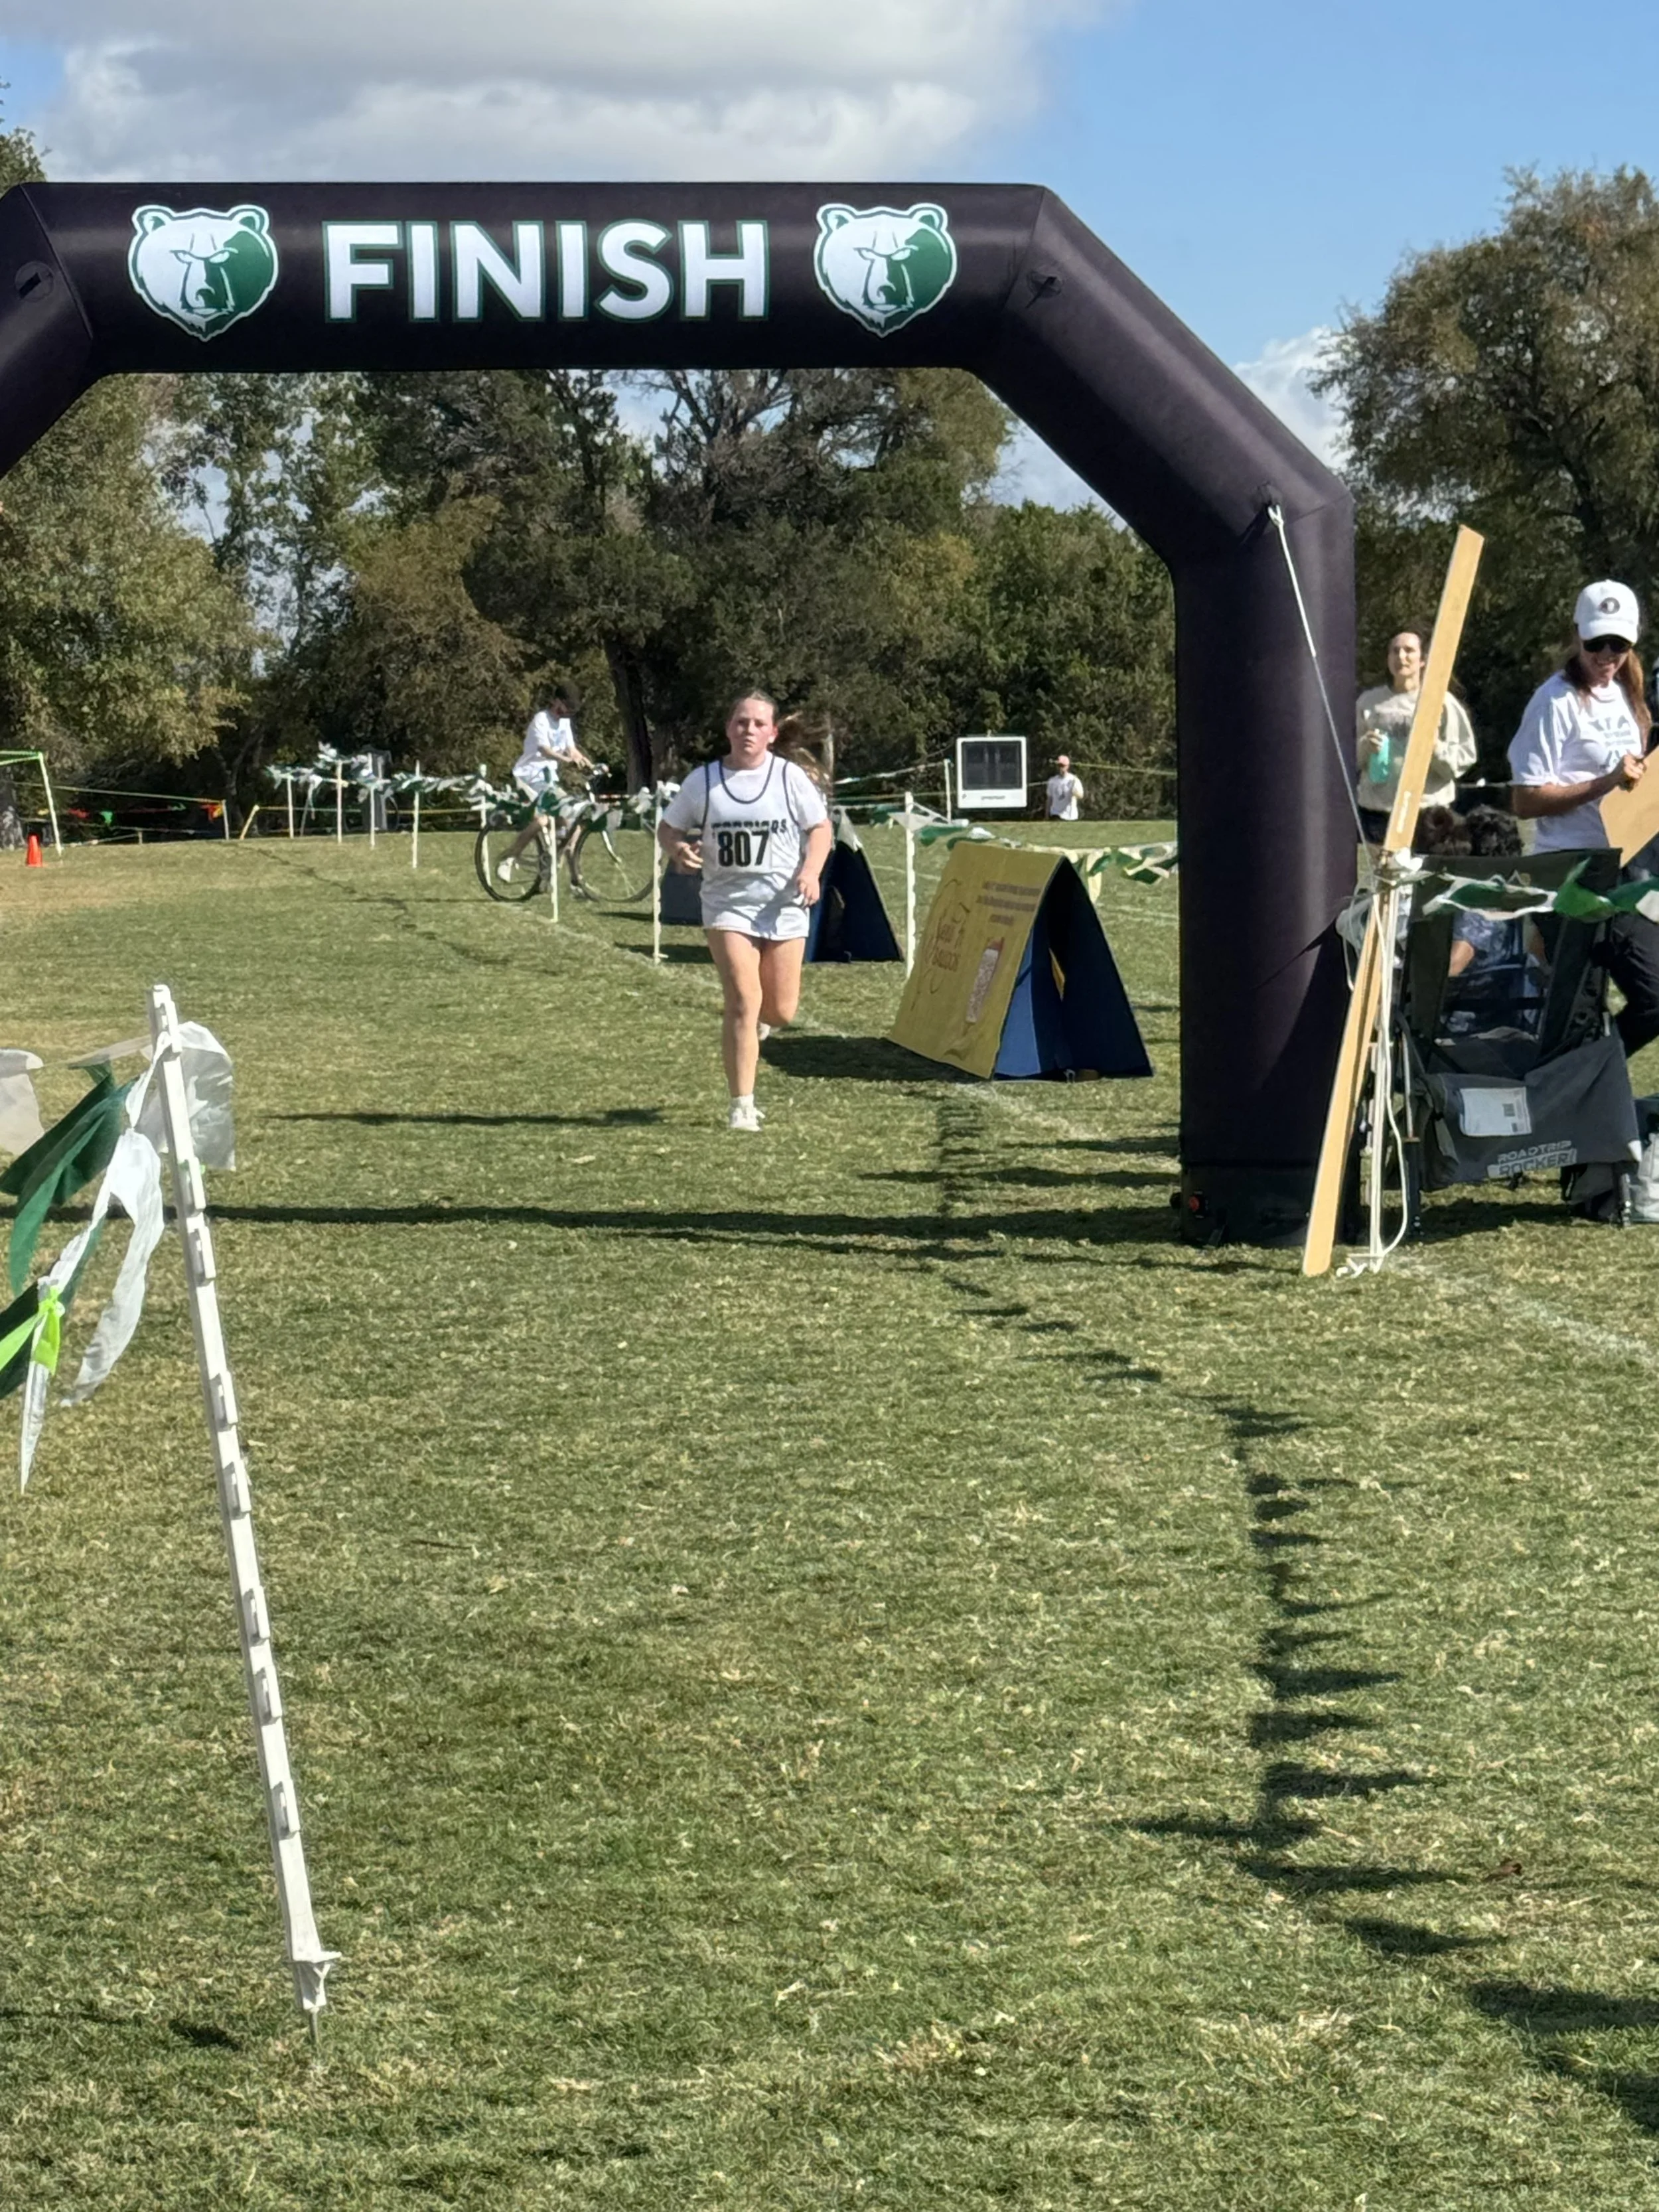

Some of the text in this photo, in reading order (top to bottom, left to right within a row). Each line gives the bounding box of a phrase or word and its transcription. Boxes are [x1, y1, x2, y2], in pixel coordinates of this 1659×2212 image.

[323, 219, 770, 325] FINISH
[717, 830, 769, 867] 807
[1498, 1140, 1572, 1162] ROADTRIP
